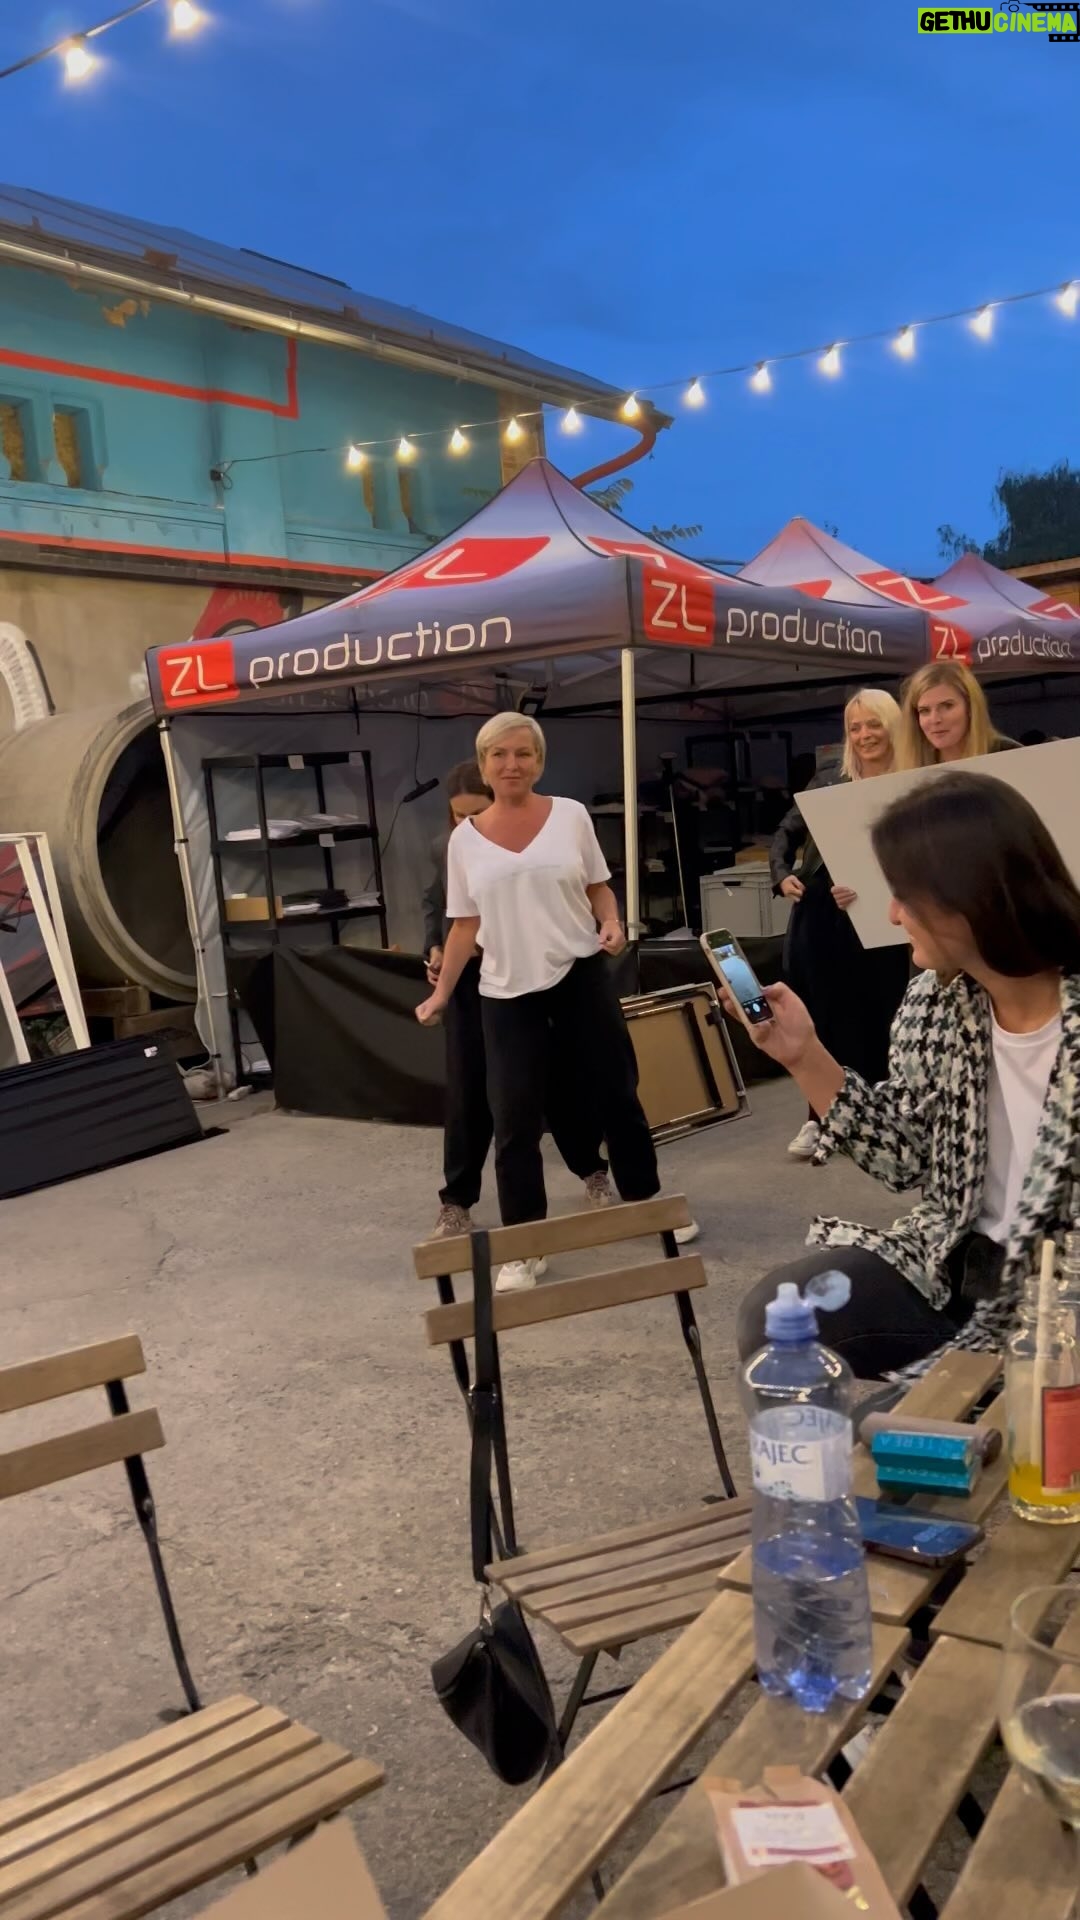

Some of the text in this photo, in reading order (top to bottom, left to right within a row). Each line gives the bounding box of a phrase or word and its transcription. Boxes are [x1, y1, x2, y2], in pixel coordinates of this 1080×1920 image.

[166, 615, 513, 697] ZL production
[651, 579, 884, 656] ZL production
[933, 625, 1075, 664] ZL production
